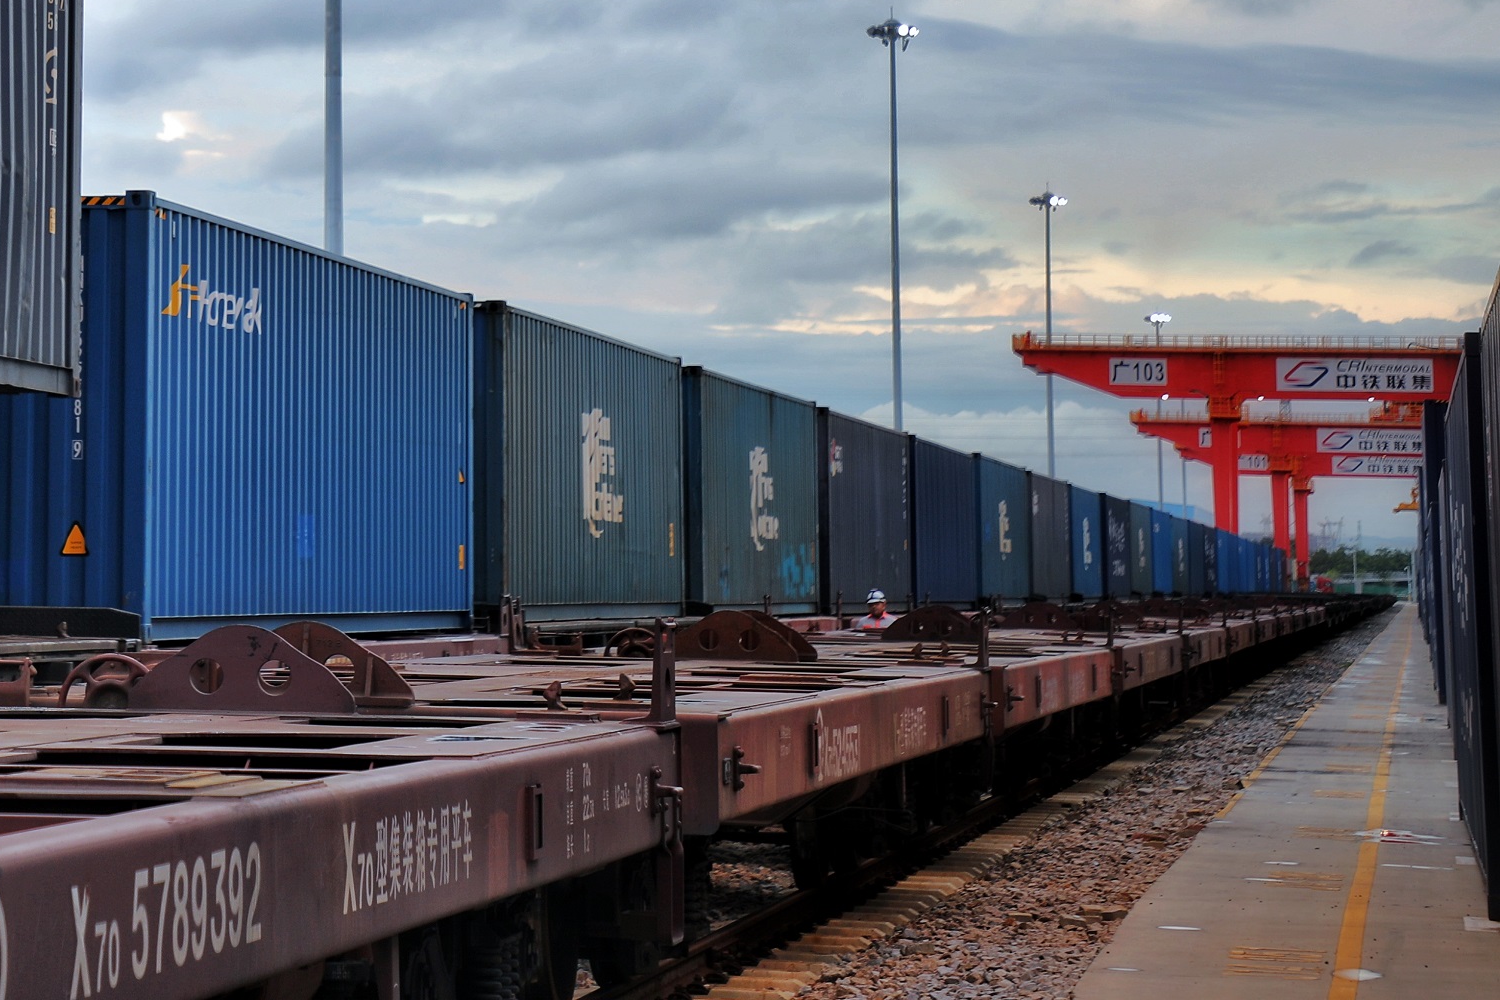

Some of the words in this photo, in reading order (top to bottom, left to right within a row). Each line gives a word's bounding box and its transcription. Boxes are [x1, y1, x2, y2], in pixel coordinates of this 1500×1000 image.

[1112, 361, 1164, 382] 广103
[1336, 374, 1431, 390] 中铁联集
[70, 884, 120, 1000] X70
[131, 841, 262, 980] 5789392
